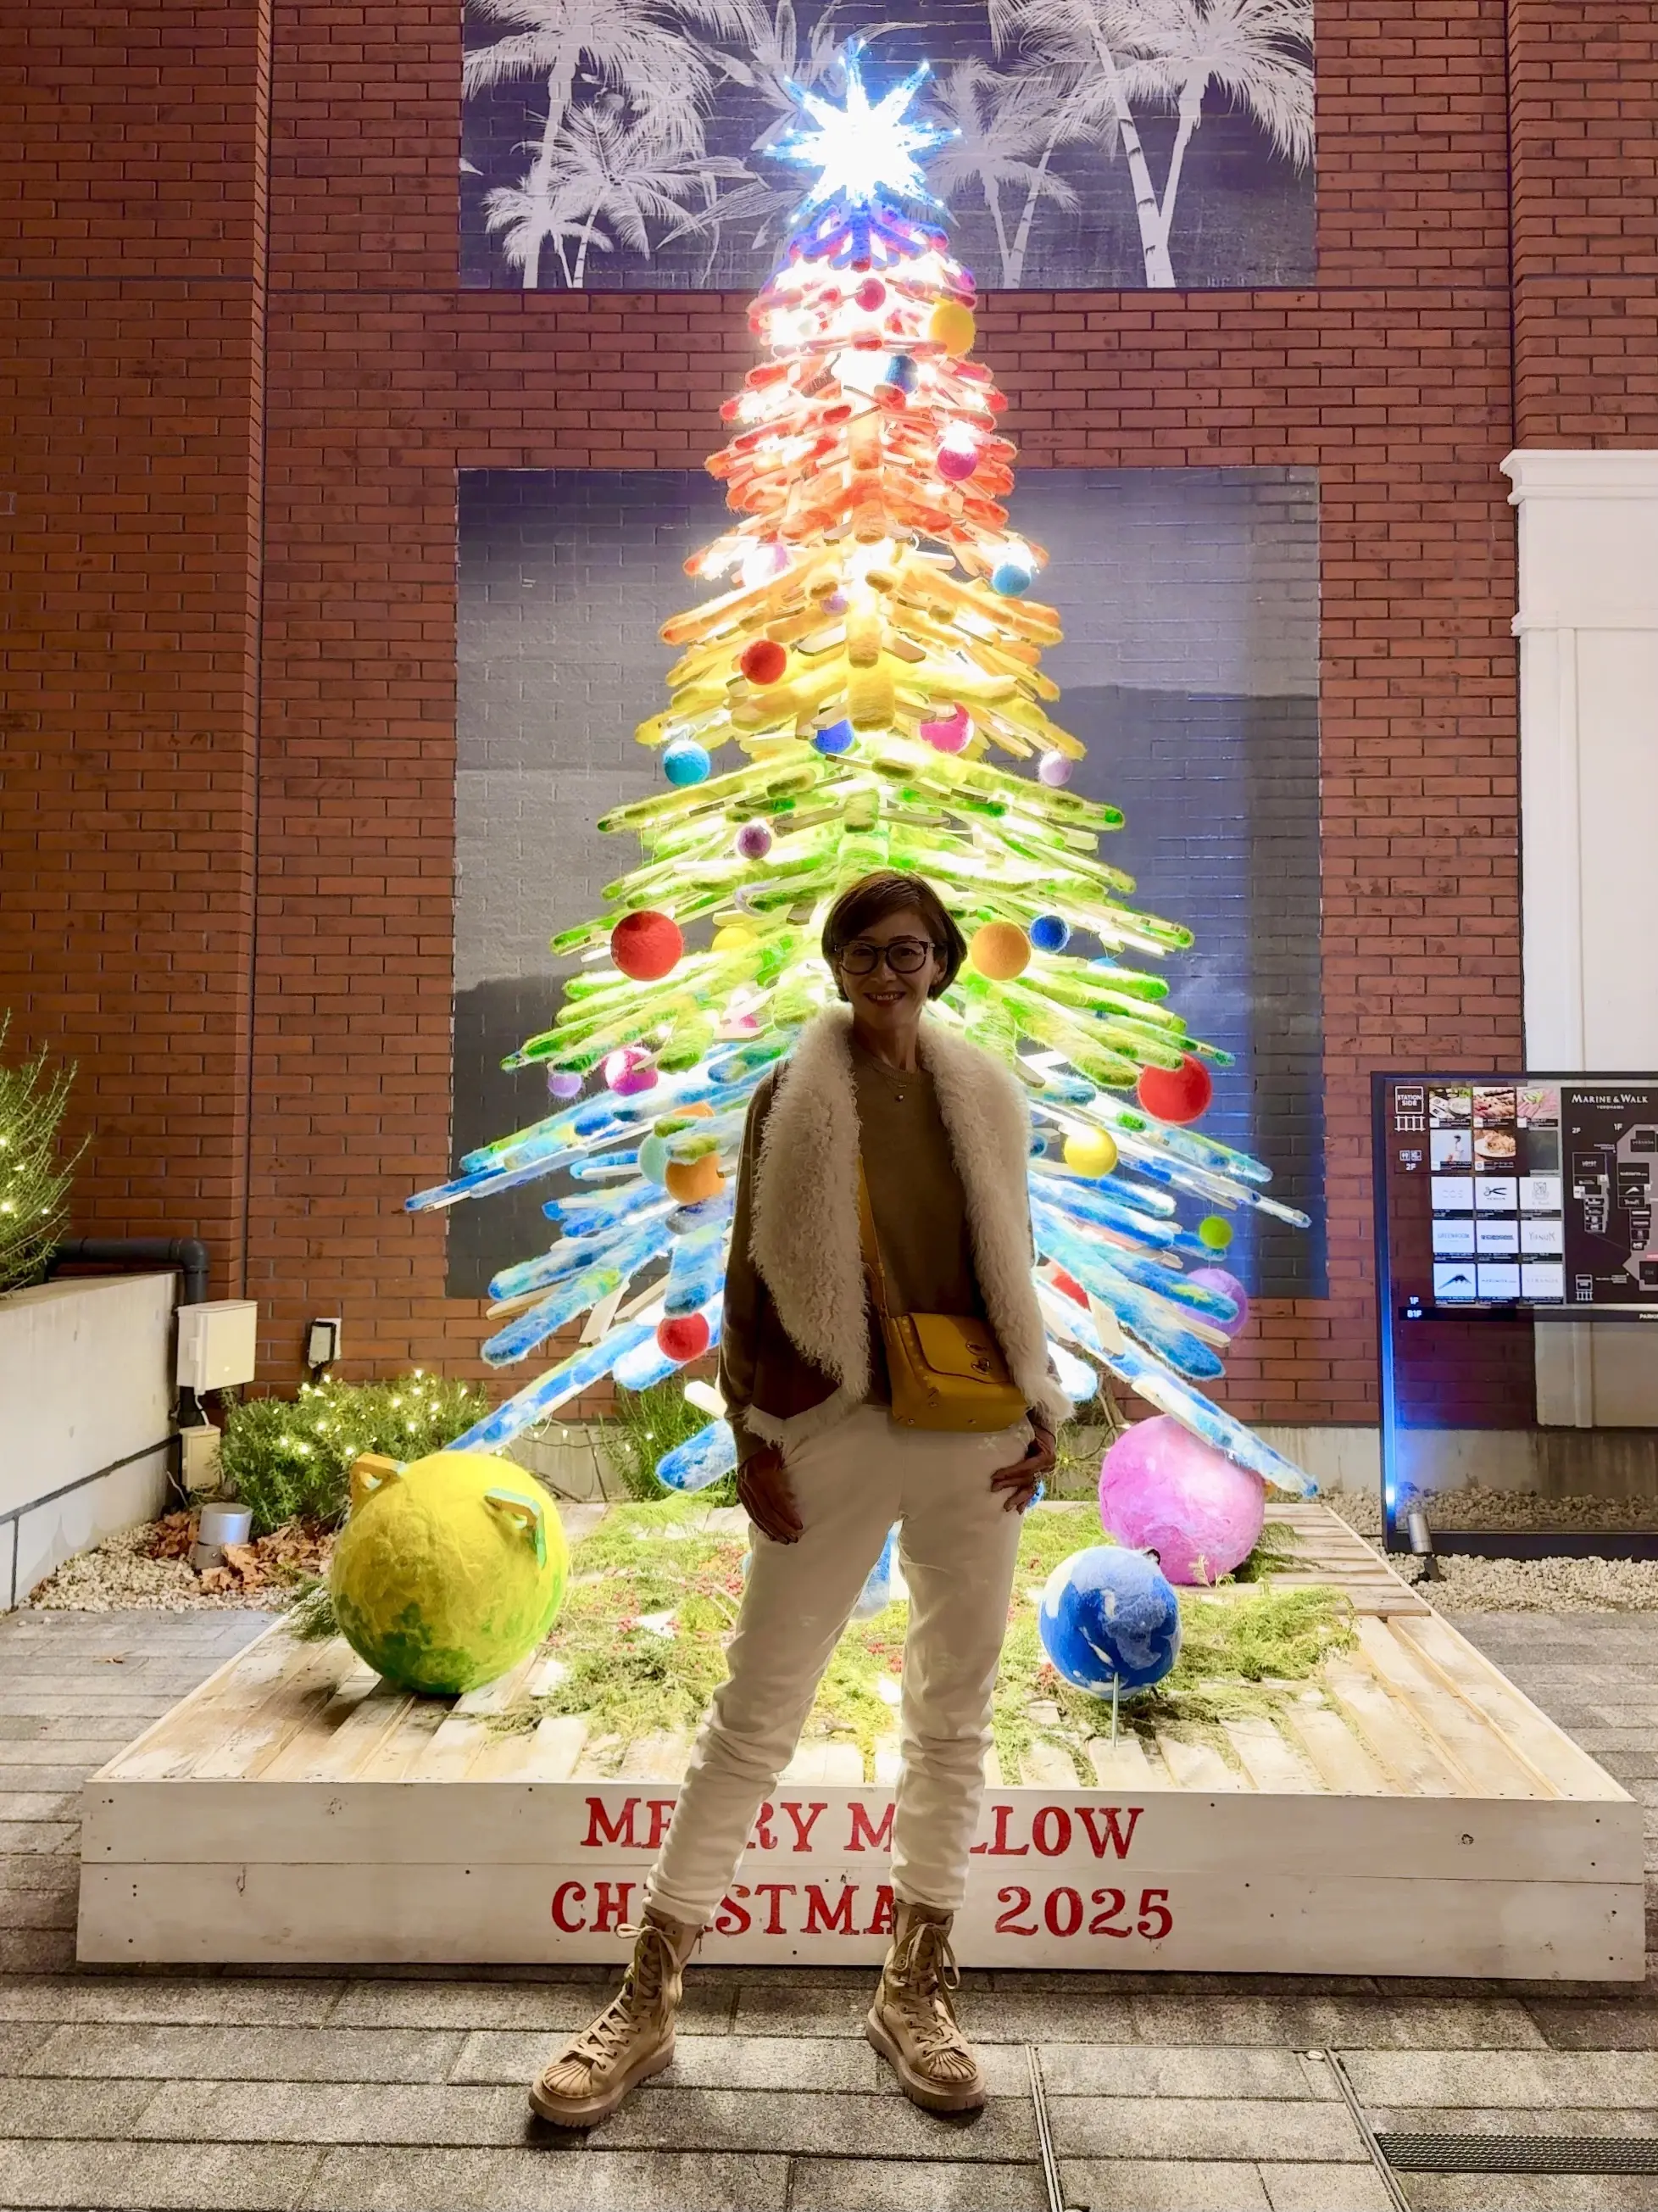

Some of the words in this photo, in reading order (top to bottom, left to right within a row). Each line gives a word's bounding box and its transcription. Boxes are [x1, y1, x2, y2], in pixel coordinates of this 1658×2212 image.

[1572, 1094, 1611, 1103] MARINE
[1620, 1094, 1649, 1103] WALK
[1613, 1123, 1623, 1131] 1F
[1405, 1162, 1417, 1171] 2F
[1409, 1296, 1420, 1305] 1F
[580, 1797, 828, 1853] MERY
[843, 1802, 1145, 1860] MLOW
[551, 1880, 895, 1936] CHSTMA
[994, 1885, 1174, 1939] 2025
